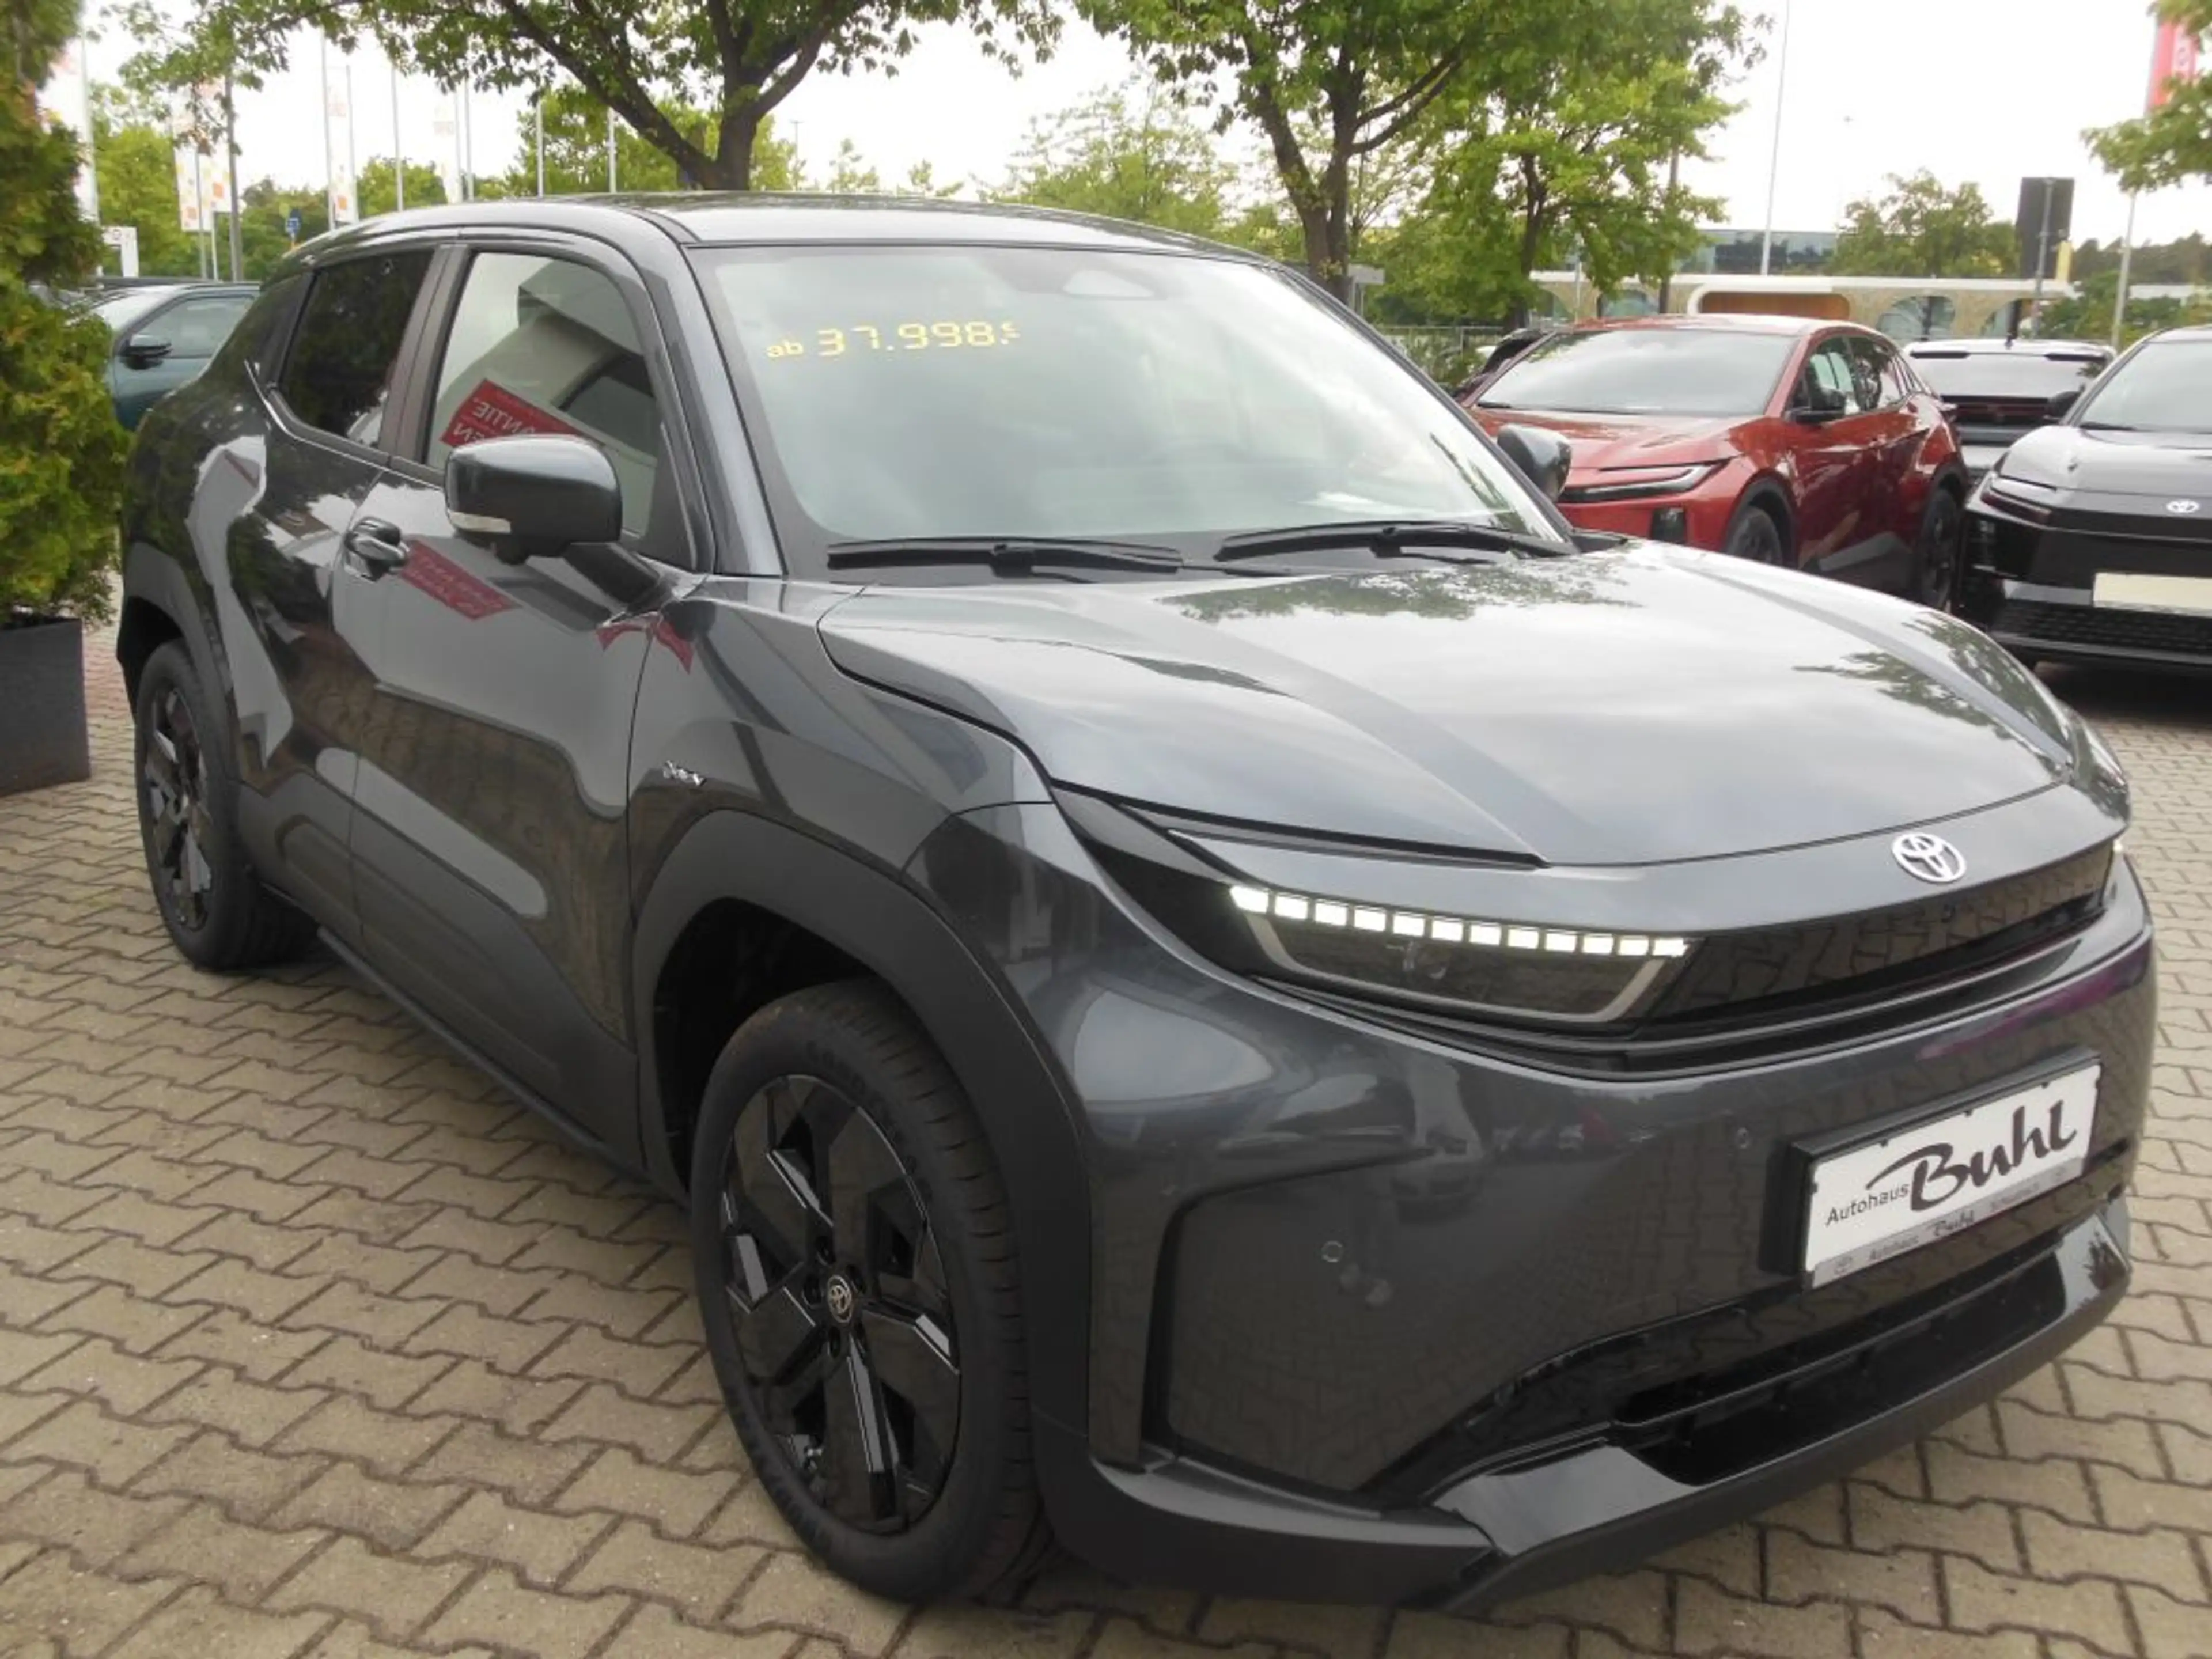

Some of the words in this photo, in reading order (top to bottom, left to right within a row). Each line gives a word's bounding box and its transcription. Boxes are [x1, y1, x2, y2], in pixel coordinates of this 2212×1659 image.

[767, 339, 804, 358] ab
[1866, 1099, 2077, 1212] Buhl
[1825, 1183, 1910, 1227] Autohaus
